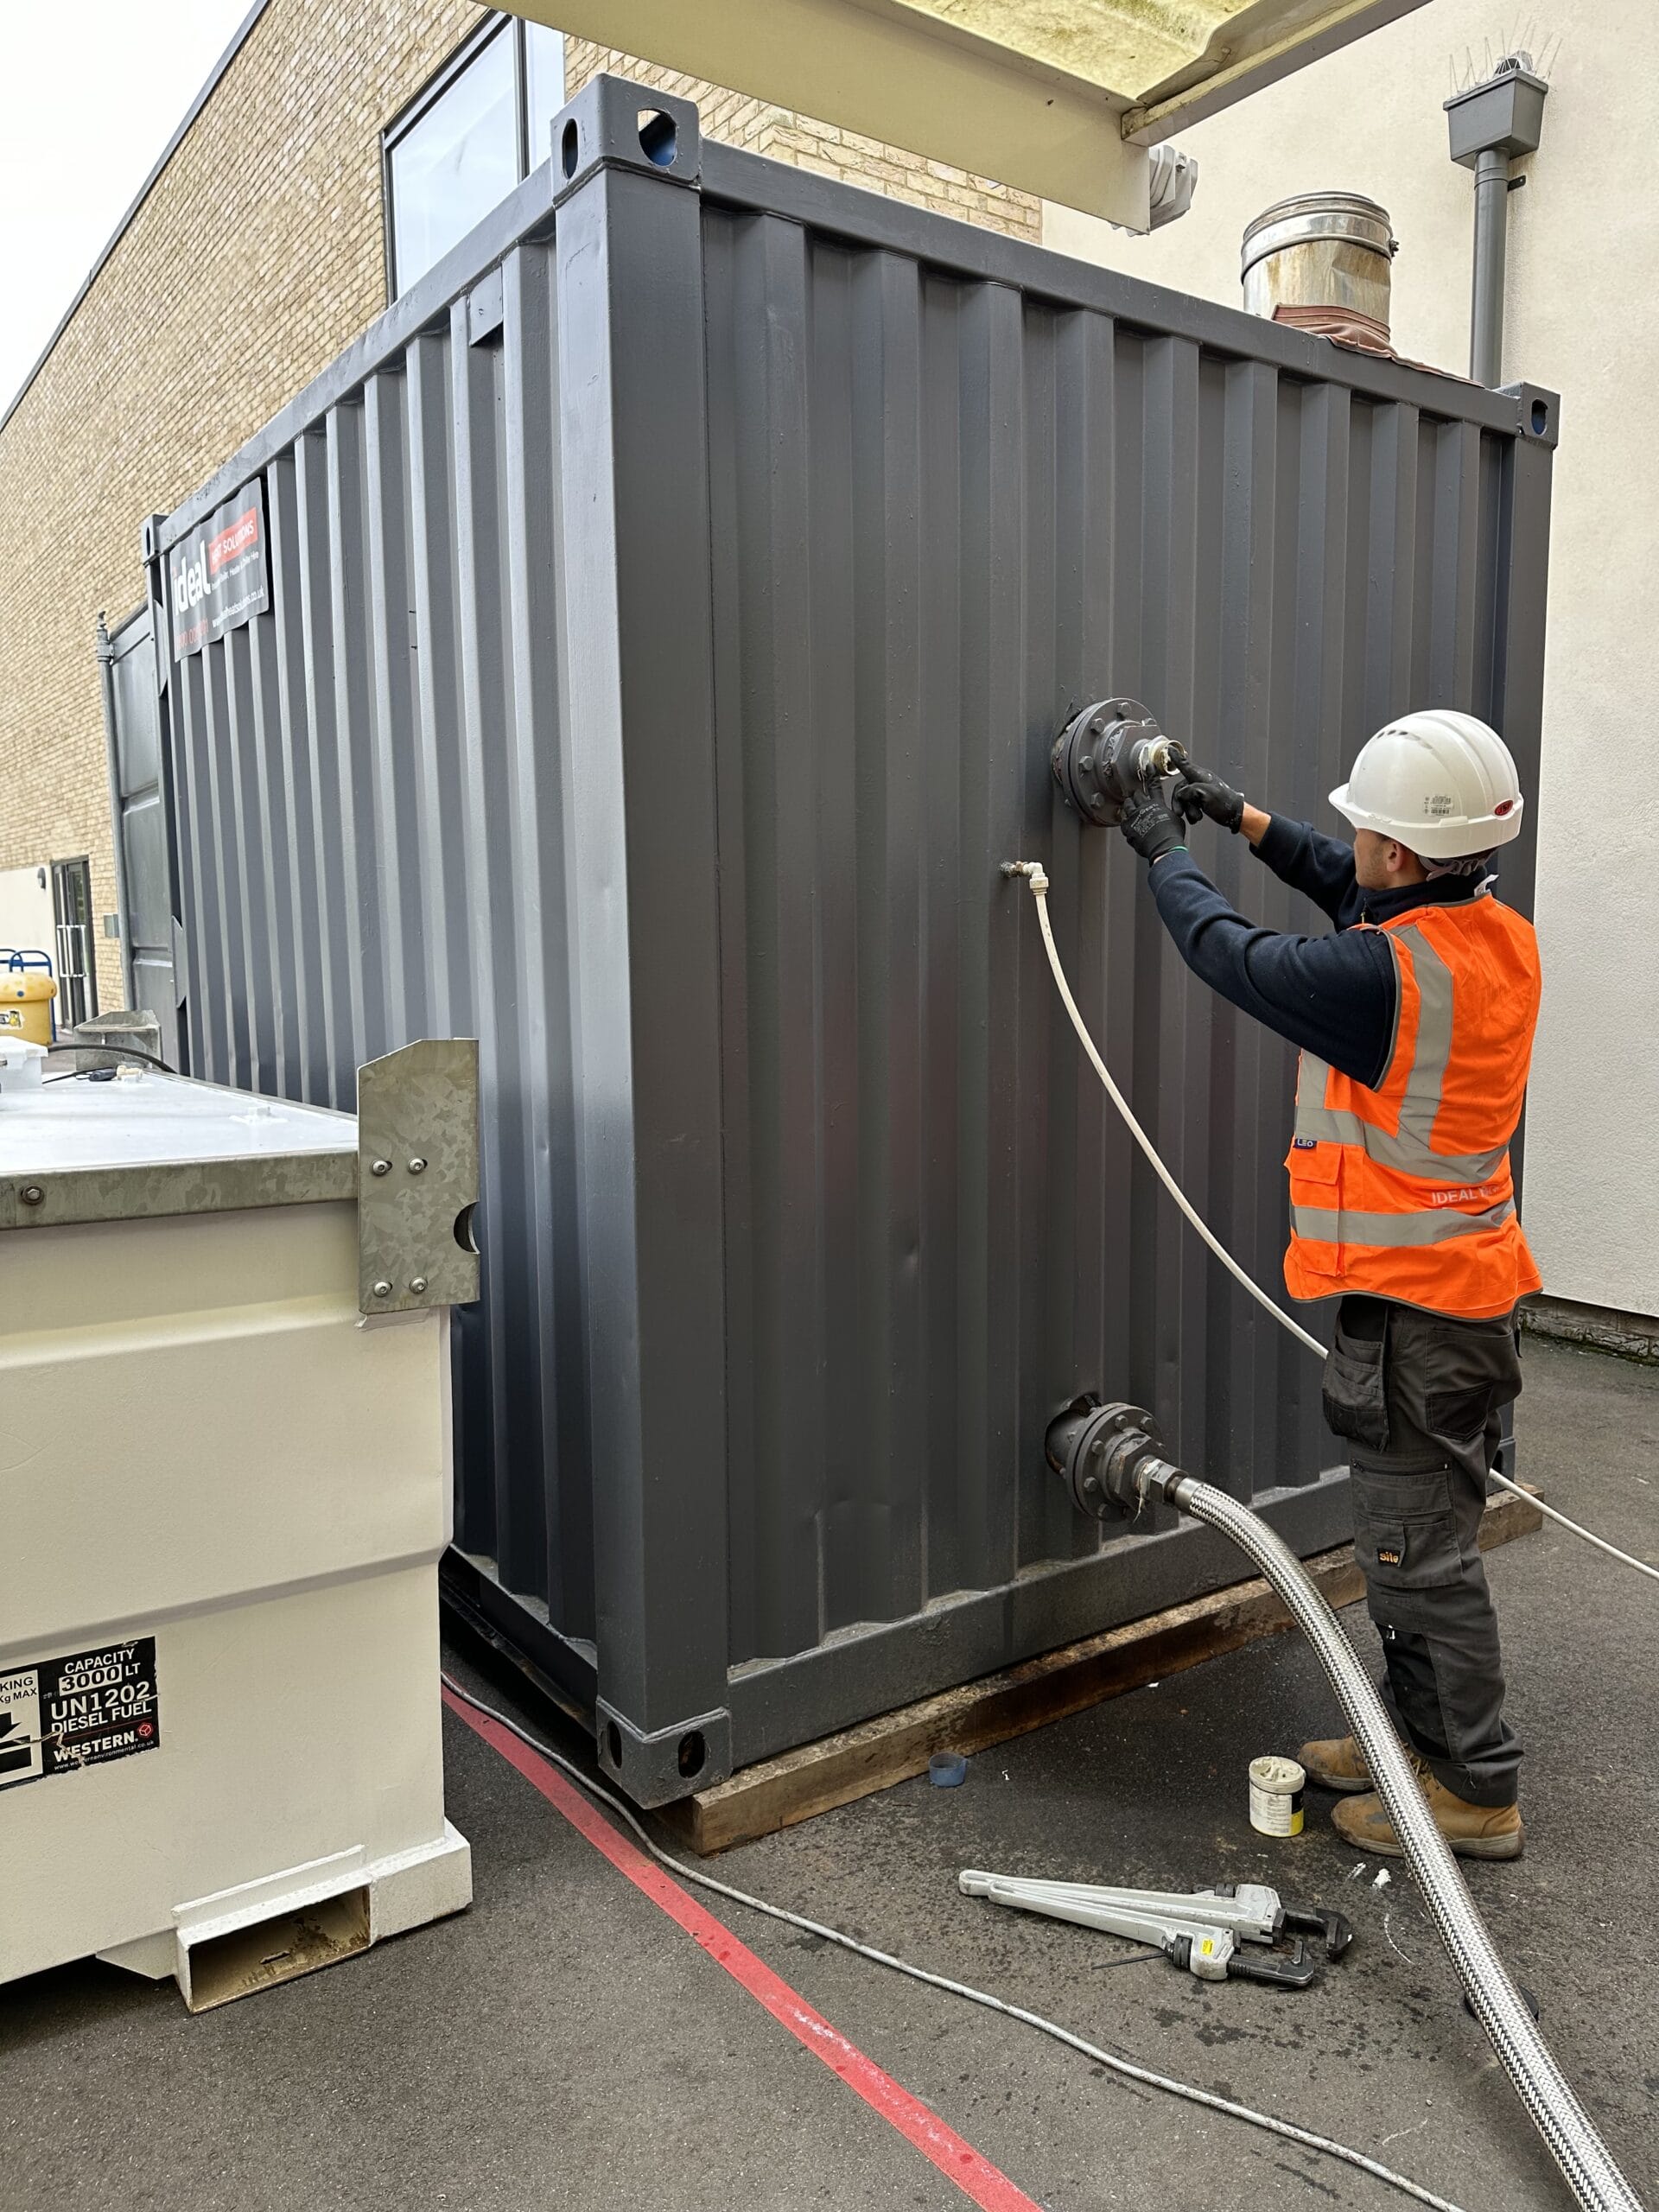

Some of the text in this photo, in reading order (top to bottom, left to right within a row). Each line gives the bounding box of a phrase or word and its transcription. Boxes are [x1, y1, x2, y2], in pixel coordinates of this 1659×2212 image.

[222, 519, 255, 555] SOLUTIONS
[173, 539, 212, 616] ideal
[1431, 1188, 1478, 1205] IDEAL
[1379, 1551, 1399, 1564] site
[65, 1648, 136, 1675] CAPACITY
[61, 1662, 141, 1693] 3000 LT
[13, 1687, 38, 1700] MAX
[51, 1681, 150, 1720] UN1202
[51, 1702, 152, 1734] DIESEL FUEL
[54, 1740, 155, 1770] www.weernenvironmental.co.uk
